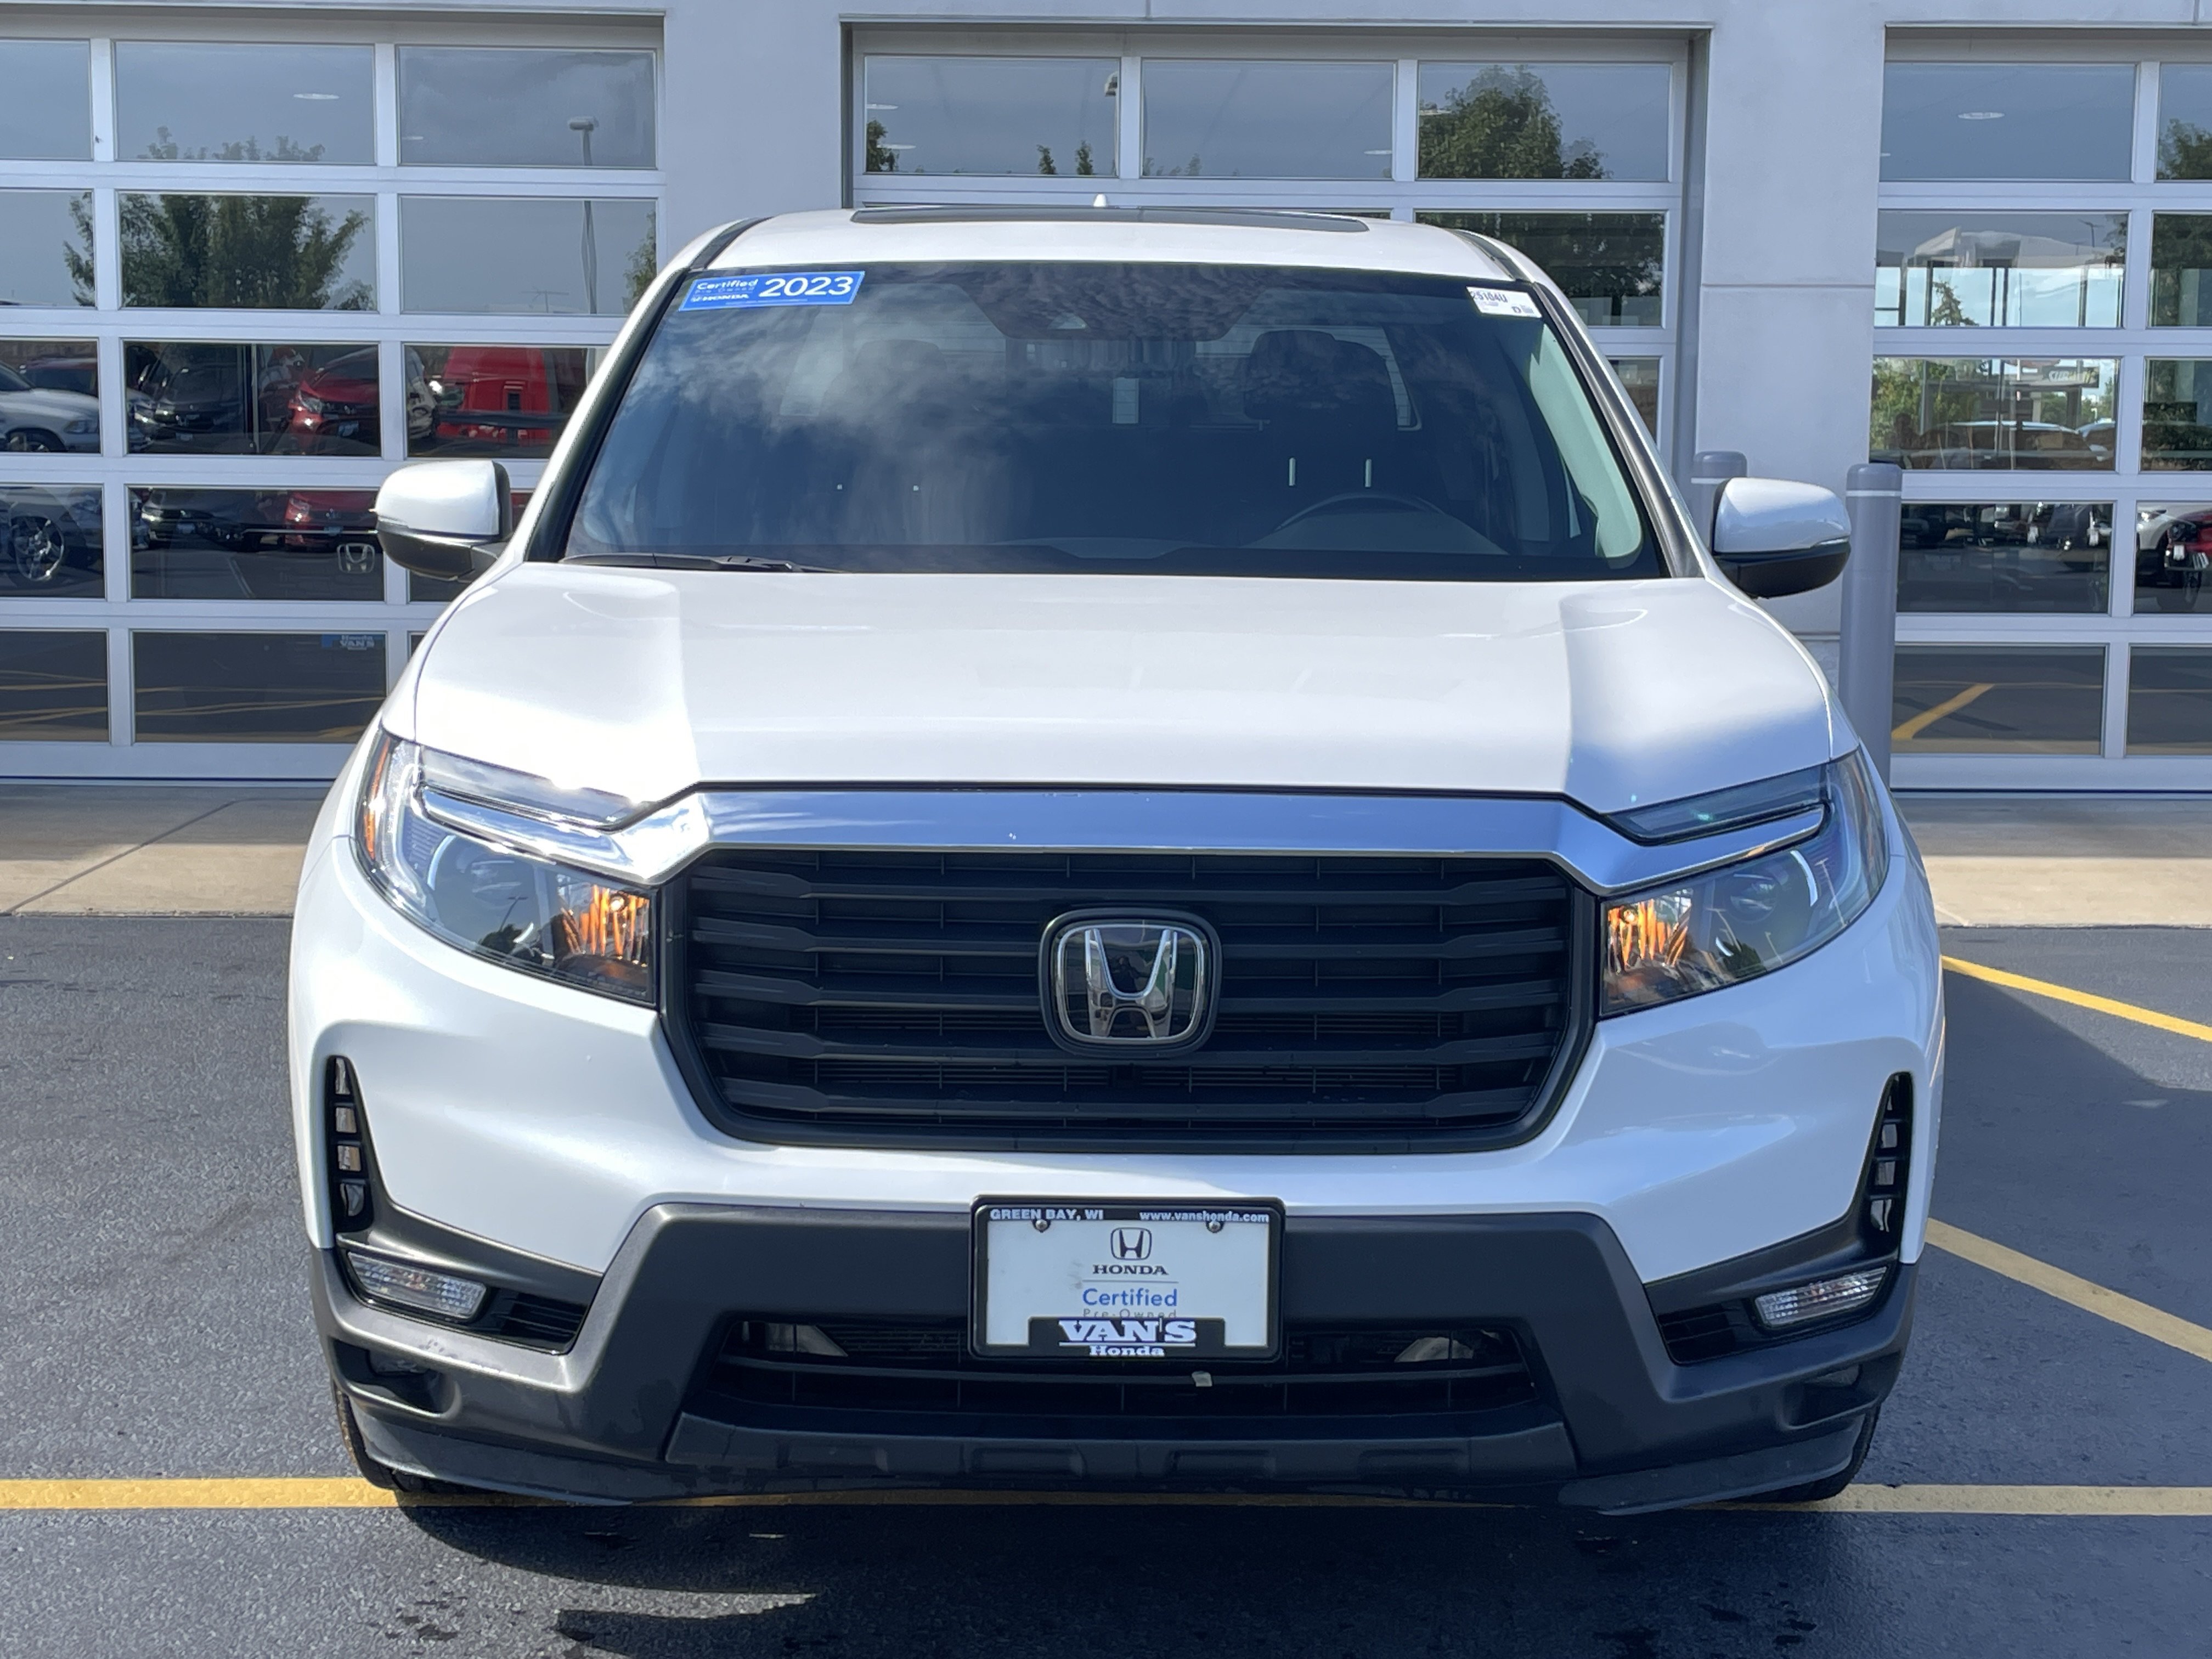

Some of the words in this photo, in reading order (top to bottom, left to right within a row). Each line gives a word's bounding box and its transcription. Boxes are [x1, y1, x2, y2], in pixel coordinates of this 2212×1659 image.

[697, 279, 759, 290] Certified
[759, 276, 854, 297] 2023
[990, 1209, 1041, 1220] GREEN
[1045, 1209, 1082, 1221] BAY,
[1085, 1209, 1104, 1220] WI
[1139, 1210, 1269, 1223] www.vanshonda.com
[1092, 1265, 1169, 1276] HONDA
[1082, 1288, 1178, 1307] Certified
[1084, 1308, 1177, 1318] Pre-Owned
[1058, 1319, 1197, 1343] VAN'S
[1089, 1345, 1165, 1357] Honda
